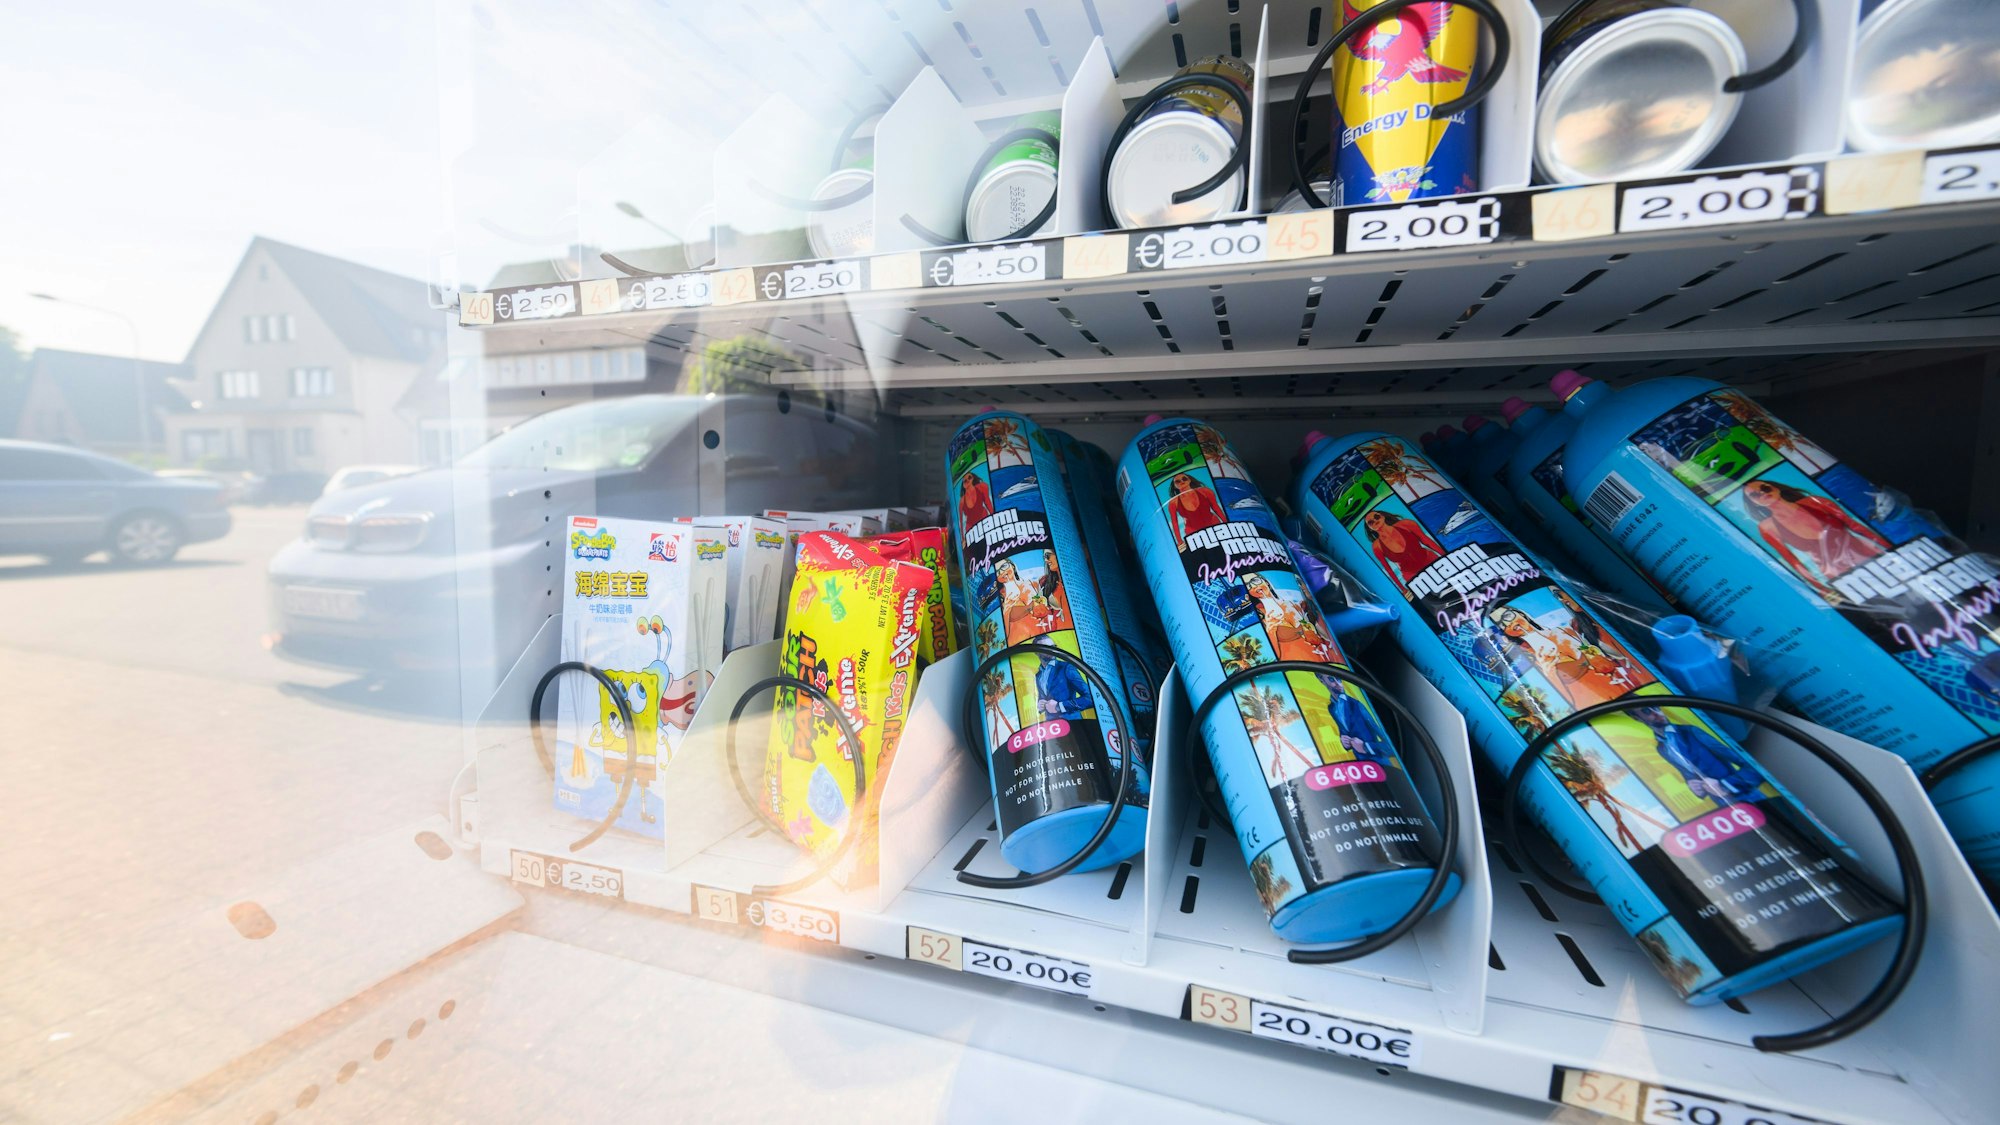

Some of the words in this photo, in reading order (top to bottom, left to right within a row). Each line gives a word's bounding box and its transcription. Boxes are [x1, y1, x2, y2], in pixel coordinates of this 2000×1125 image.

[1342, 109, 1408, 148] Energy
[1545, 201, 1602, 233] 46
[1639, 187, 1772, 222] 2,00
[1273, 219, 1321, 252] 45
[1361, 215, 1468, 244] 2,00
[1172, 233, 1261, 259] 2.00
[652, 281, 709, 304] 2.50
[719, 273, 750, 301] 42
[790, 270, 855, 292] 2.50
[466, 297, 490, 320] 40
[519, 292, 568, 313] 2.50
[590, 284, 614, 309] 41
[1635, 502, 1658, 525] E942
[969, 533, 1048, 578] Infusions
[1197, 552, 1292, 586] Infusions
[575, 571, 649, 597] 海绵宝宝
[884, 585, 891, 593] OZ
[880, 605, 887, 616] WT
[1437, 566, 1541, 637] Infusions
[878, 617, 886, 628] NET
[858, 649, 870, 673] SOUR
[885, 670, 909, 720] Kids
[1013, 723, 1062, 749] 640G
[1013, 765, 1024, 776] DO
[1025, 758, 1043, 770] NOT
[1045, 751, 1075, 763] REFILL
[1315, 764, 1378, 787] 640G
[1005, 784, 1018, 797] NOT
[1019, 777, 1033, 788] FOR
[1036, 765, 1074, 781] MEDICAL
[1077, 762, 1095, 771] USE
[1016, 794, 1027, 805] DO
[1029, 787, 1046, 798] NOT
[1049, 778, 1082, 791] INHALE
[1323, 807, 1339, 819] DO
[1343, 802, 1364, 814] NOT
[1368, 800, 1401, 810] REFILL
[1309, 828, 1331, 842] NOT
[1335, 822, 1357, 835] FOR
[1361, 815, 1405, 828] MEDICAL
[1406, 816, 1424, 827] USE
[1335, 840, 1352, 853] DO
[1355, 835, 1379, 847] NOT
[1381, 831, 1419, 843] INHALE
[1675, 808, 1755, 851] 640G
[520, 858, 541, 880] 50
[1703, 874, 1725, 890] DO
[1726, 861, 1755, 880] NOT
[1755, 845, 1800, 867] REFILL
[569, 871, 620, 892] 2,50
[1697, 901, 1724, 920] NOT
[1726, 886, 1755, 907] FOR
[1815, 857, 1840, 872] USE
[709, 895, 735, 917] 51
[1736, 912, 1759, 930] DO
[1760, 897, 1790, 918] NOT
[770, 908, 834, 935] 3,50
[919, 935, 952, 963] 52
[972, 950, 1092, 989] 20.00€
[1199, 993, 1239, 1025] 53
[1259, 1011, 1411, 1059] 20.00€
[1576, 1070, 1631, 1112] 54
